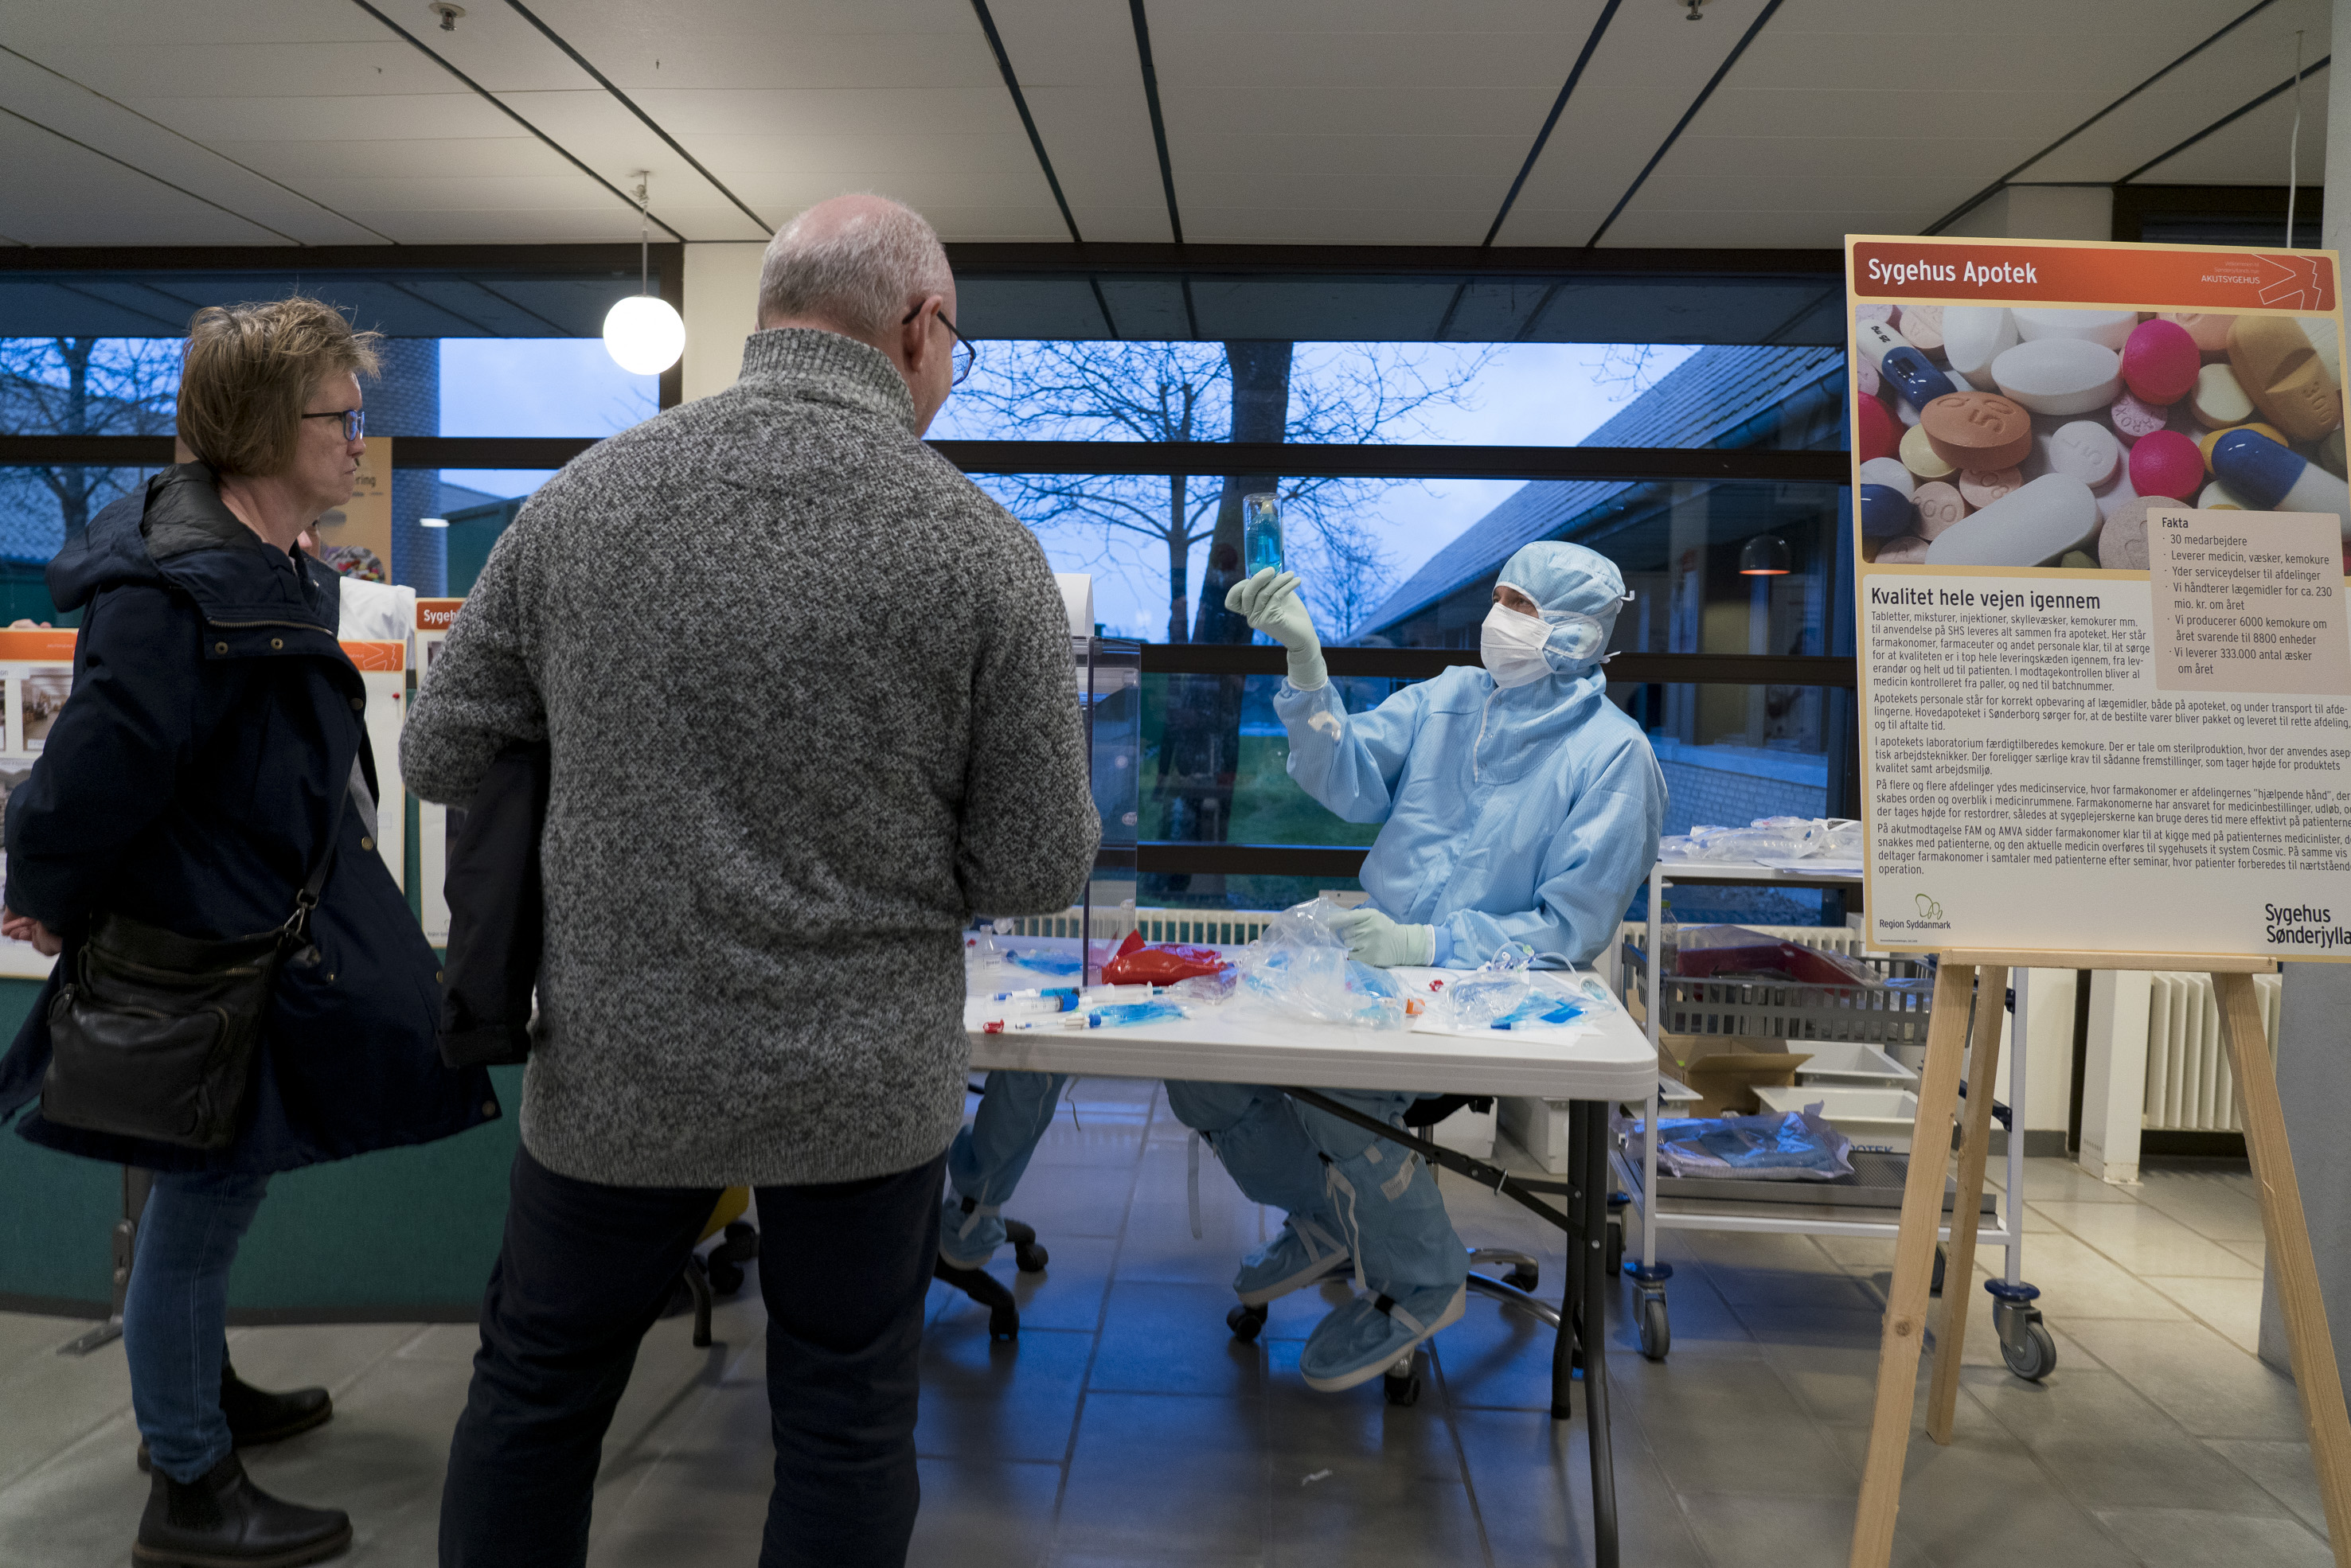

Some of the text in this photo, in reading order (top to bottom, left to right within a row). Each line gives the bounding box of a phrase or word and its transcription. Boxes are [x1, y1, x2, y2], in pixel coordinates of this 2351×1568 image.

[1869, 258, 2037, 287] Sygehus Apotek
[2201, 275, 2260, 284] AKUTSYGEHUS
[355, 474, 377, 488] ring
[2162, 517, 2189, 529] Fakta
[2170, 534, 2248, 548] 30 medarbejdere
[2171, 550, 2330, 565] Leverer medicin, væsker, kemokure
[2172, 566, 2321, 582] Yder serviceydelser til afdelinger
[2173, 582, 2181, 592] Vi
[2185, 581, 2229, 594] håndterer
[2232, 584, 2283, 596] lægemidler
[2285, 585, 2298, 595] for
[2316, 587, 2332, 597] 230
[1872, 587, 2100, 612] Kvalitet hele vejen igennem
[2174, 599, 2245, 610] mio. kr. om året
[1872, 611, 1912, 622] Tabletter,
[1914, 612, 1958, 623] miksturer,
[1960, 613, 2009, 625] injektioner,
[2011, 614, 2068, 626] skyllevæsker,
[2071, 616, 2117, 626] kemokurer
[2175, 614, 2184, 624] Vi
[2186, 615, 2236, 626] producerer
[2240, 616, 2263, 627] 6000
[2266, 617, 2310, 629] kemokure
[1872, 624, 2146, 640] til anvendelse på SHS leveres alt sammen fra apoteket. Her står
[2176, 630, 2317, 645] året svarende til 8800 enheder
[1873, 649, 1885, 660] for
[1888, 650, 1896, 660] at
[1900, 651, 1942, 661] kvaliteten
[1957, 652, 1959, 661] i
[1962, 652, 1976, 664] top
[1978, 653, 1997, 662] hele
[2000, 653, 2068, 665] leveringskæden
[2071, 654, 2111, 666] igennem,
[2113, 655, 2125, 665] fra
[2128, 656, 2143, 665] lev-
[2174, 647, 2312, 661] Vi leverer 333.000 antal æsker
[2195, 662, 2213, 674] året
[1874, 693, 2348, 715] Apotekets personale står for korrekt opbevaring af lægemidler, både på apoteket, og under transport til afde-
[1875, 736, 1877, 746] I
[1880, 737, 1923, 748] apotekets
[1927, 737, 1983, 748] laboratorium
[1986, 738, 2059, 751] færdigtilberedes
[2061, 740, 2107, 751] kemokure.
[2109, 741, 2124, 751] Der
[2138, 742, 2154, 752] tale
[2173, 743, 2245, 755] sterilproduktion,
[2248, 745, 2267, 755] hvor
[2270, 746, 2284, 755] der
[2287, 747, 2328, 757] anvendes
[1876, 763, 1992, 777] kvalitet samt arbejdsmiljø.
[1877, 778, 1887, 790] På
[1889, 779, 1910, 790] flere
[1912, 782, 1923, 793] og
[1926, 780, 1947, 791] flere
[1949, 781, 1994, 794] afdelinger
[1997, 782, 2017, 794] ydes
[2020, 783, 2088, 795] medicinservice,
[2091, 784, 2111, 794] hvor
[2113, 785, 2177, 796] farmakonomer
[2192, 786, 2251, 800] afdelingernes
[2337, 791, 2351, 801] der
[1878, 850, 2351, 872] deltager farmakonomer i samtaler med patienterne efter seminar, hvor patienter forberedes til nærtståend
[1879, 864, 1924, 876] operation.
[2265, 903, 2331, 926] Sygehus
[1879, 919, 1951, 930] Region Syddanmark
[2267, 925, 2351, 949] Sønderjylla
